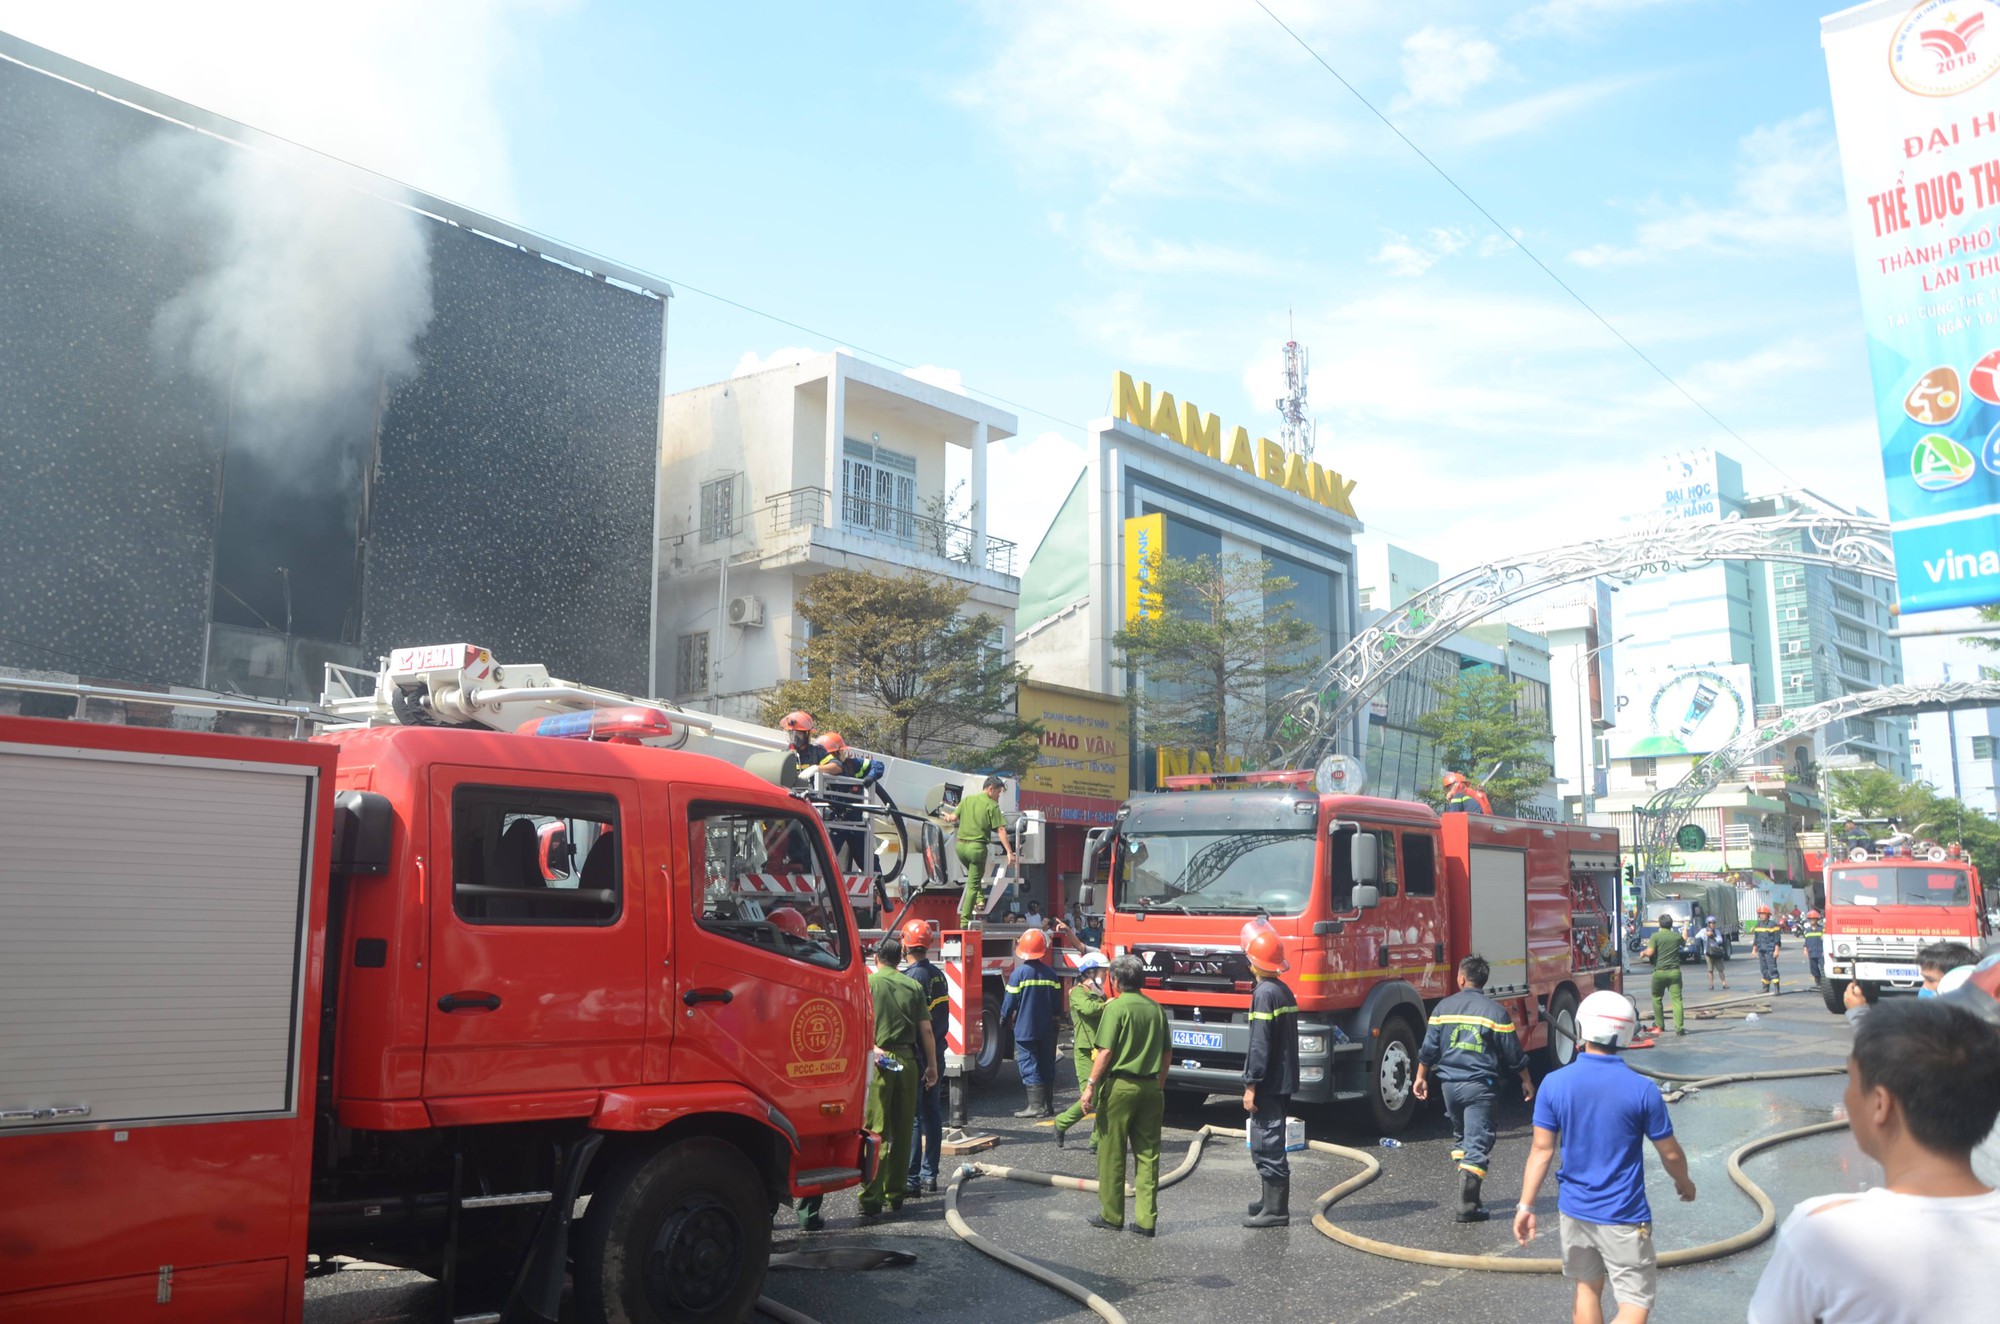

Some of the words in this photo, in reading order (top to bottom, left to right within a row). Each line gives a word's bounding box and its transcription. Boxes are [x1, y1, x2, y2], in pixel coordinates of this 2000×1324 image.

[1935, 51, 1977, 75] 2018
[1903, 123, 1960, 159] ĐẠI
[1866, 170, 1911, 238] THỂ
[1915, 171, 1965, 228] DỤC
[1877, 243, 1943, 275] THÀNH
[1948, 221, 1991, 255] PHỐ
[1113, 370, 1221, 461] NAM
[1223, 425, 1257, 477] A
[1258, 437, 1358, 521] BANK
[1665, 487, 1683, 504] ĐẠI
[1688, 483, 1711, 499] HỌC
[1684, 499, 1714, 518] NẴNG
[1138, 528, 1149, 579] BANK
[1084, 735, 1116, 756] VÂN
[1174, 961, 1223, 974] MAN
[809, 1035, 826, 1047] 114
[793, 1064, 814, 1075] PCCC
[820, 1062, 840, 1073] CNCH
